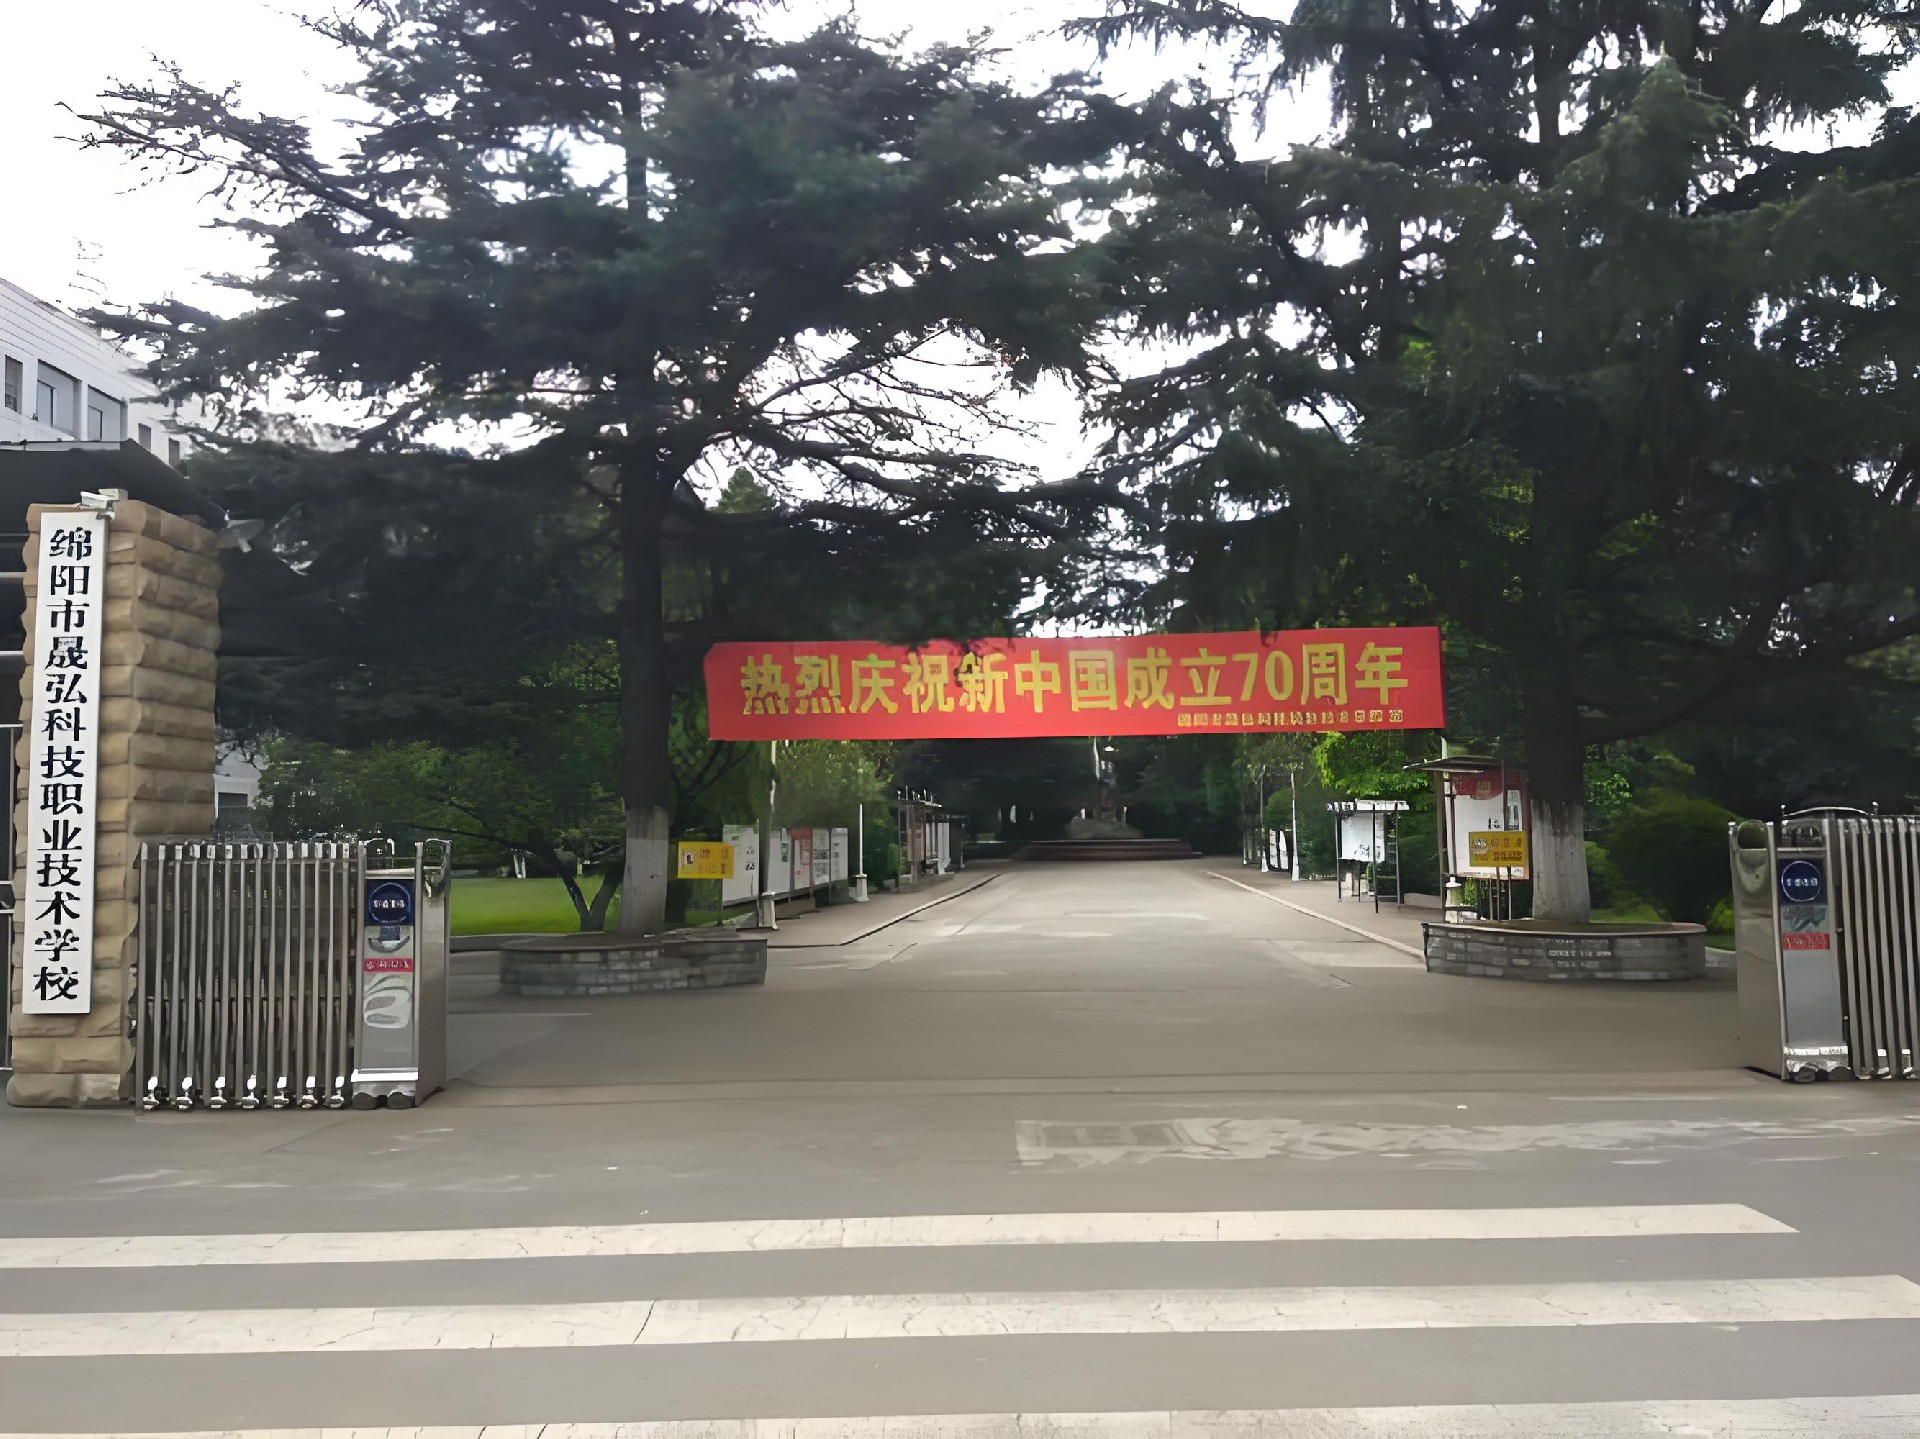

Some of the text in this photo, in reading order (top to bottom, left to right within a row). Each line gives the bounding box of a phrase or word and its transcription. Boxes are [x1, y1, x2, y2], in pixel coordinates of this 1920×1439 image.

[33, 526, 92, 1001] 绵阳市晟弘科技职业技术学校
[740, 642, 1408, 715] 热烈庆祝新中国成立70周年
